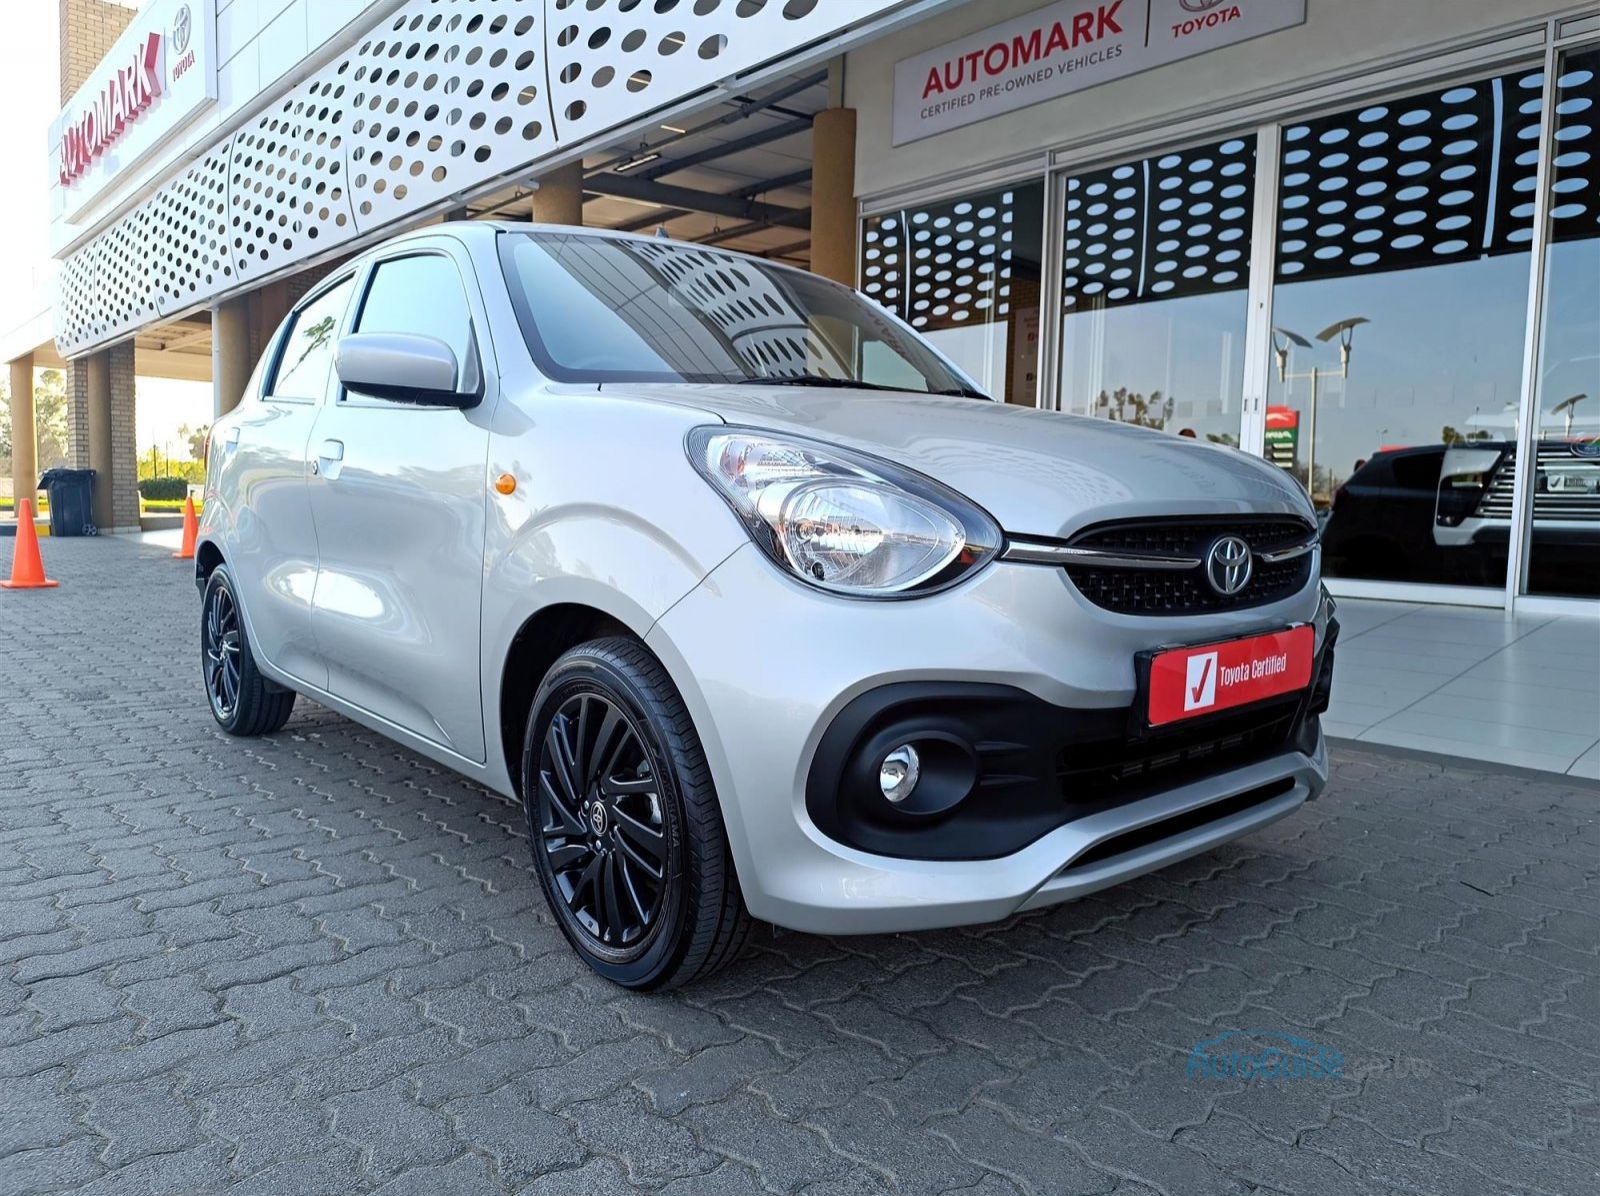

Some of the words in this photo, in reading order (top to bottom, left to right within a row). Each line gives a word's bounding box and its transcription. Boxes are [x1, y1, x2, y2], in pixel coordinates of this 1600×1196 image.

[921, 0, 1124, 99] AUTOMARK
[1171, 6, 1242, 39] TOYOTA
[60, 32, 162, 186] AUTOMARK
[920, 92, 976, 120] CERTIFIED
[979, 66, 1054, 101] PRE-OWNED
[1057, 43, 1124, 75] VEHICLES
[1220, 662, 1249, 687] Toyota
[1251, 653, 1287, 679] Certified
